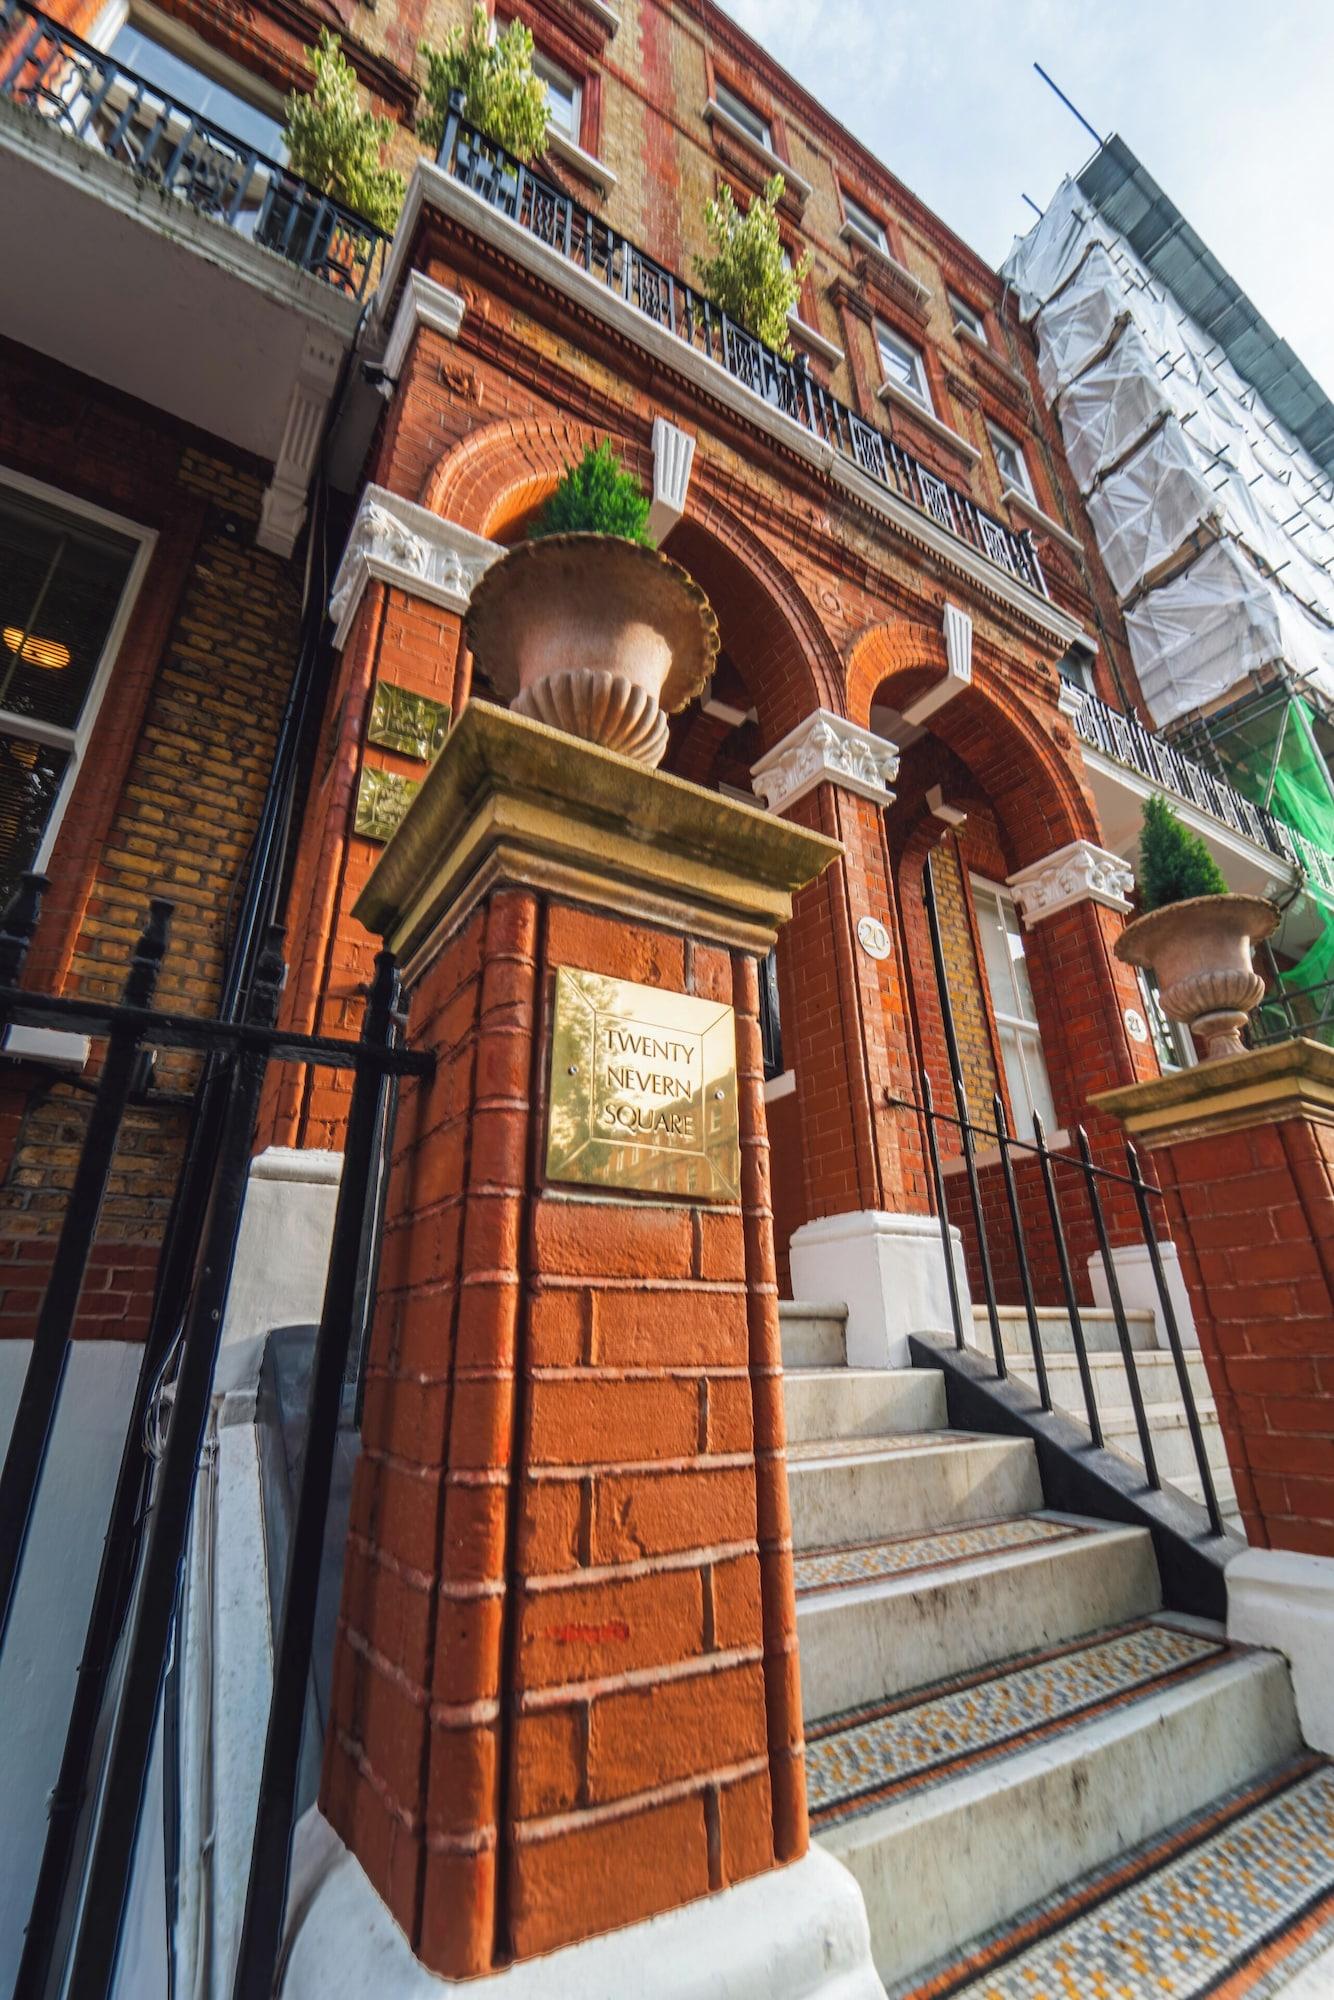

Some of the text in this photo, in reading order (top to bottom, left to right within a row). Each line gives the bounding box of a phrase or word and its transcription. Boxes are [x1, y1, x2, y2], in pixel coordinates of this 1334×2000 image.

[860, 922, 885, 951] 20
[1127, 1015, 1141, 1033] 21
[603, 1028, 695, 1065] TWENTY
[607, 1065, 691, 1099] NEVERN
[604, 1104, 694, 1136] SQUARE
